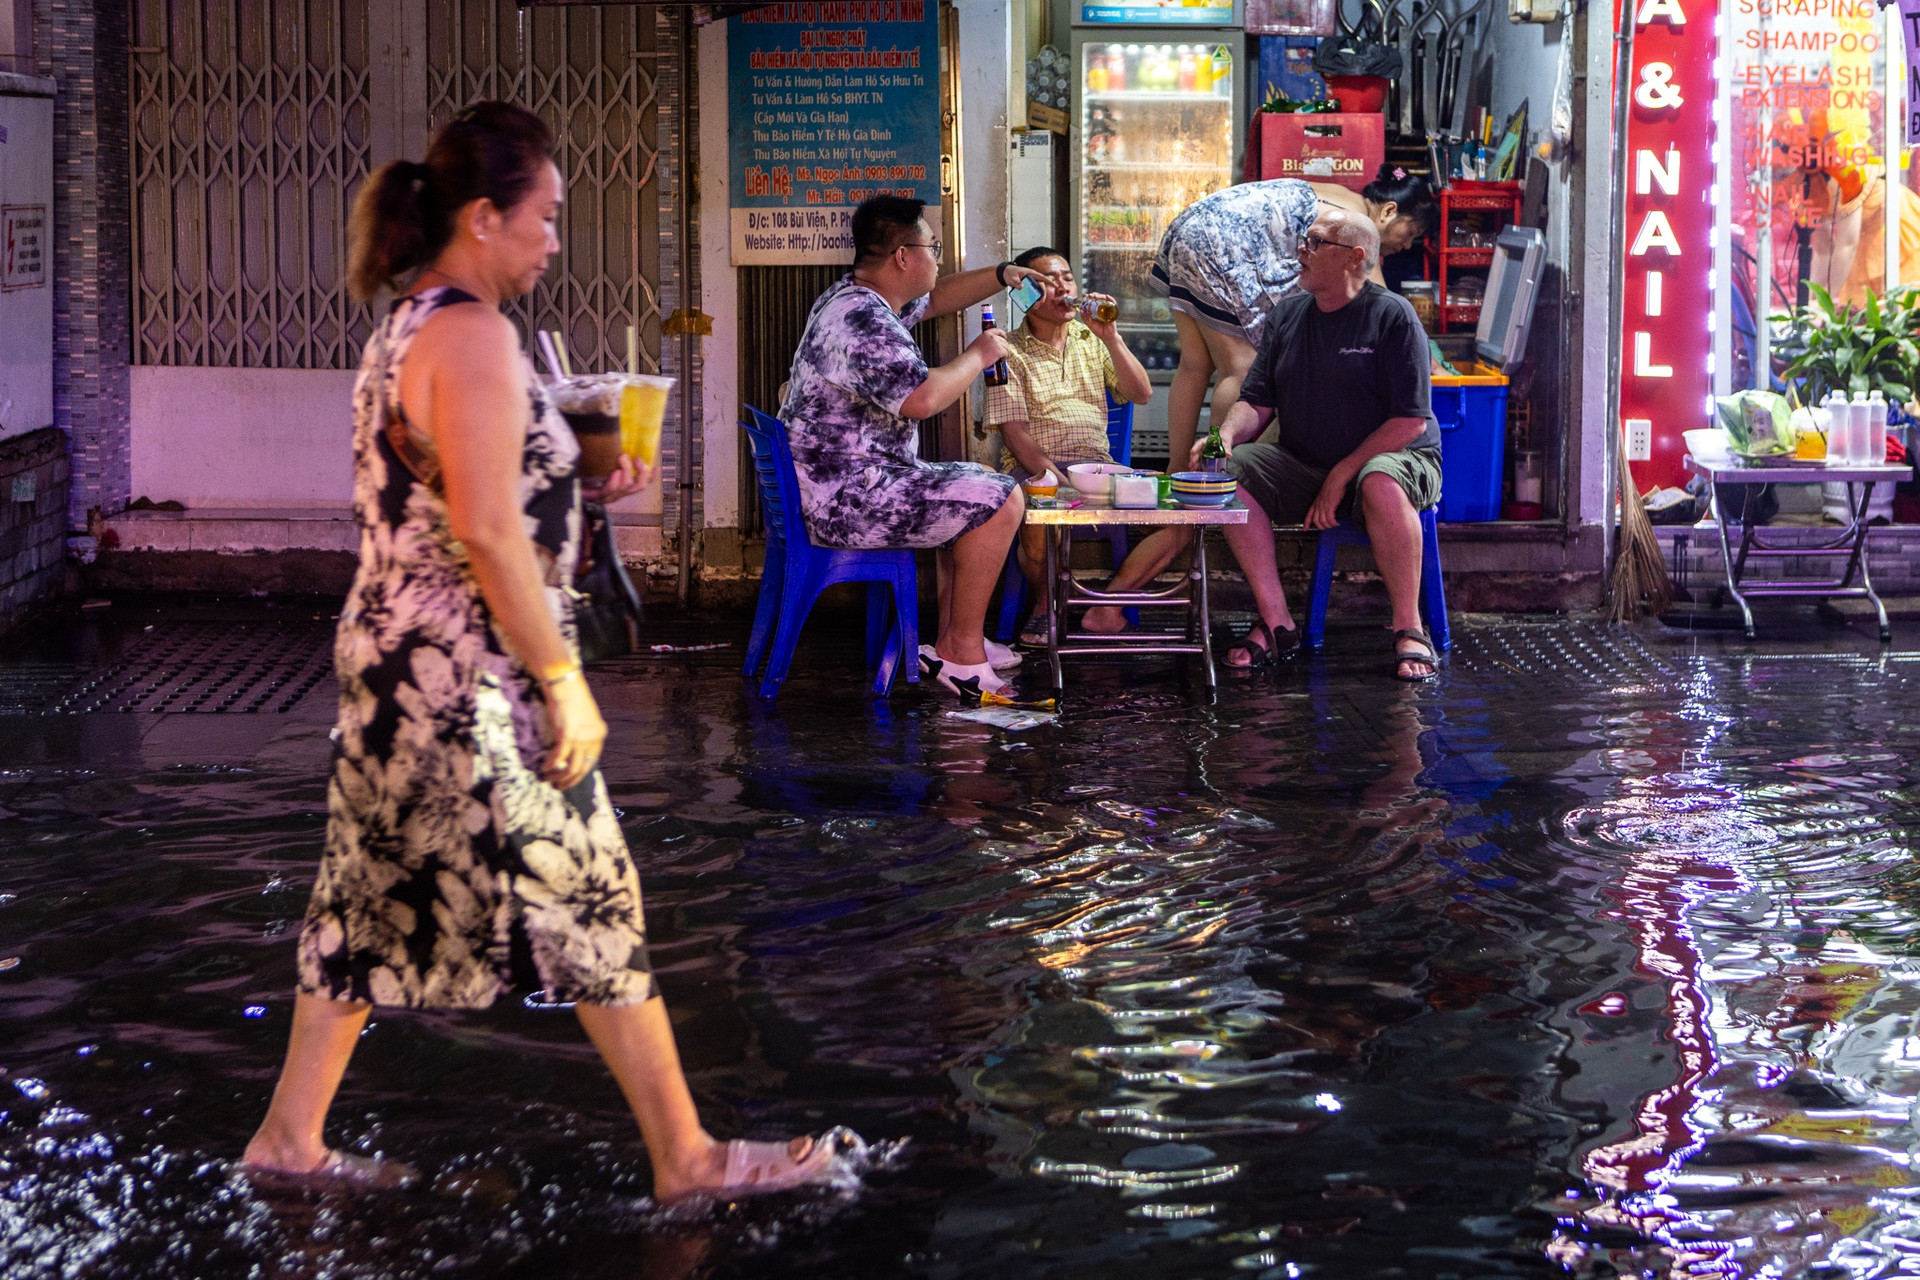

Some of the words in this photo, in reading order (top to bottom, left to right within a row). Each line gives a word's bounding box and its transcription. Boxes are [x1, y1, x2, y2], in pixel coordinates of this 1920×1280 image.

[900, 2, 924, 22] MINH
[1637, 0, 1687, 24] A
[1739, 0, 1875, 18] SCRAPING
[903, 52, 910, 67] Y
[785, 75, 792, 87] &
[1636, 62, 1684, 109] &
[785, 93, 792, 105] &
[872, 92, 883, 104] TN
[1742, 89, 1880, 111] EXTENSIONS
[810, 111, 825, 123] Gia
[753, 130, 769, 142] Thu
[817, 130, 823, 141] Y
[853, 129, 868, 141] Gia
[754, 148, 771, 160] Thu
[1746, 145, 1869, 168] WASHING
[746, 165, 770, 196] Liên
[797, 167, 813, 181] Ms.
[865, 166, 888, 180] 0903
[890, 166, 907, 180] 890
[909, 166, 926, 180] 702
[807, 190, 822, 204] Mr.
[749, 212, 769, 230] Đ/c:
[772, 212, 787, 228] 108
[791, 212, 804, 228] Bùi
[831, 212, 838, 228] P.
[1752, 207, 1822, 229] CARE
[745, 234, 785, 251] Website:
[1631, 149, 1683, 377] NAIL
